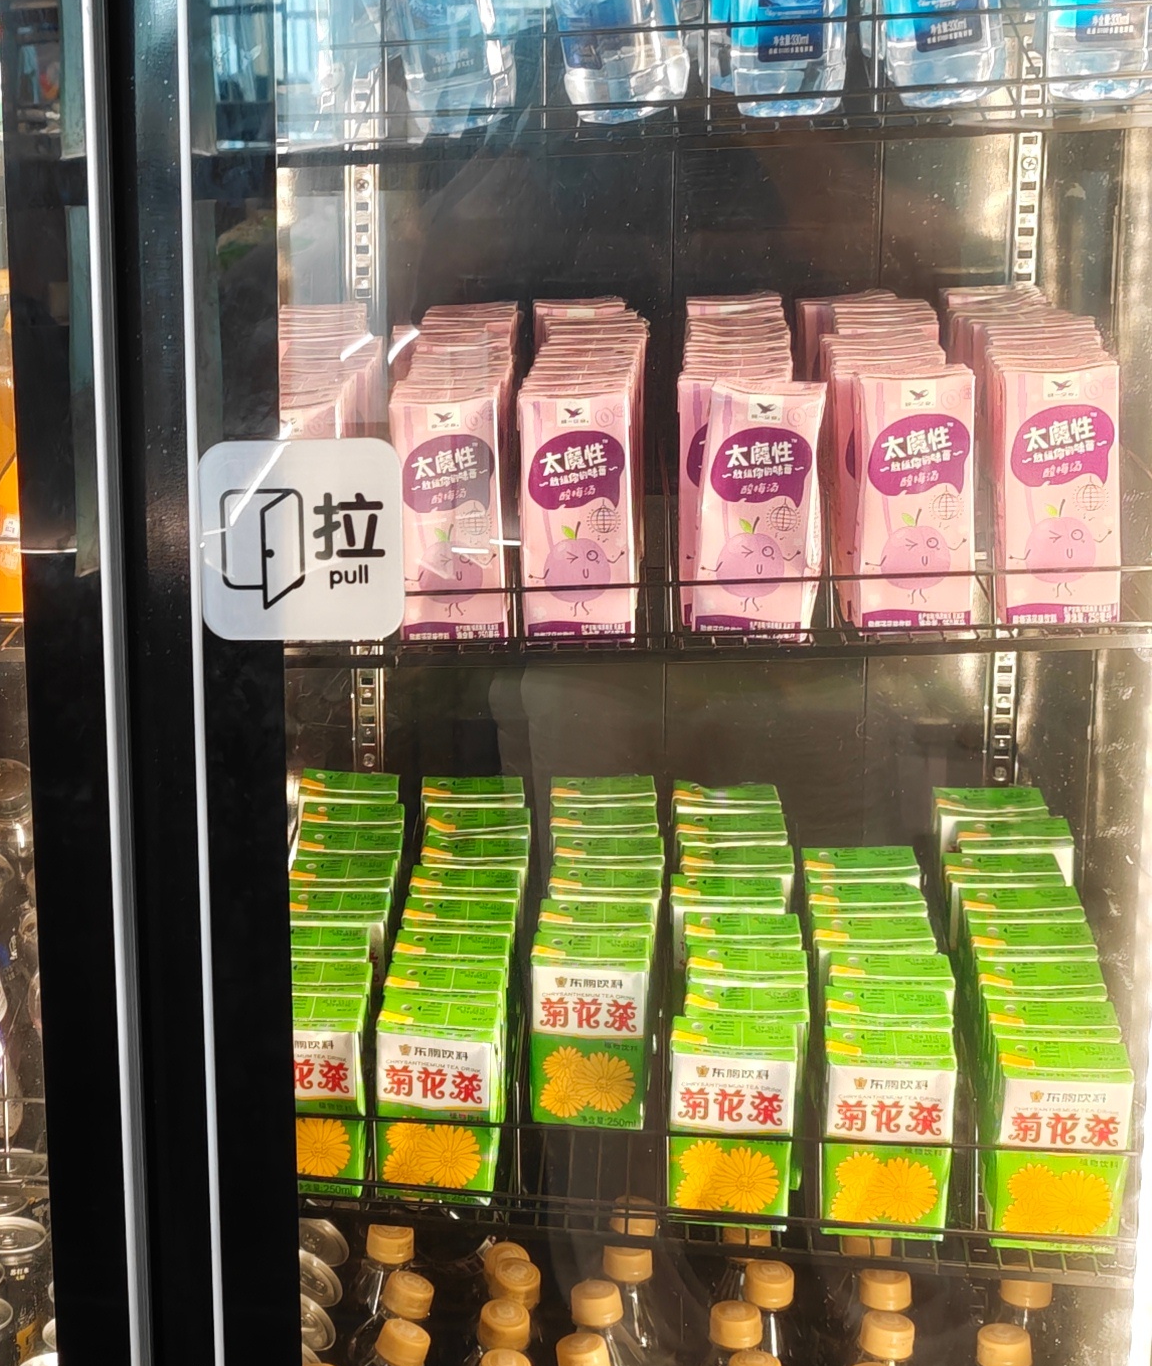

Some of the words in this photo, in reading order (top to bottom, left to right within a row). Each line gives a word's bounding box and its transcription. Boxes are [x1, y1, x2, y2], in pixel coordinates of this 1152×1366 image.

[881, 425, 953, 462] 太魔性
[1022, 415, 1097, 453] 太魔性
[410, 444, 479, 481] 太魔性
[539, 442, 608, 477] 太魔性
[724, 440, 795, 468] 太魔性
[548, 466, 608, 487] 放纵你的味蕾
[732, 465, 794, 480] 放纵你的味蕾
[899, 471, 940, 488] 酸梅汤
[429, 489, 468, 505] 酸梅汤
[557, 485, 597, 502] 酸梅汤
[739, 482, 780, 496] 酸梅汤
[313, 492, 386, 560] 拉
[329, 563, 370, 589] pull
[568, 978, 624, 989] 东鹏饮料
[615, 994, 636, 1002] DRINK
[539, 997, 638, 1033] 菊花茶
[413, 1046, 469, 1062] 东鹏饮料
[294, 1059, 350, 1094] 花茶
[385, 1059, 446, 1069] CHRYSANTHEMUM
[461, 1066, 482, 1075] DRINK
[711, 1067, 770, 1081] 东鹏饮料
[383, 1064, 483, 1105] 菊花茶
[870, 1078, 929, 1091] 东鹏饮料
[677, 1087, 784, 1127] 菊花茶
[1046, 1092, 1107, 1104] 东鹏饮料
[580, 1115, 637, 1128] 净含量:250ml
[834, 1099, 944, 1137] 菊花茶
[1008, 1112, 1121, 1148] 菊花茶
